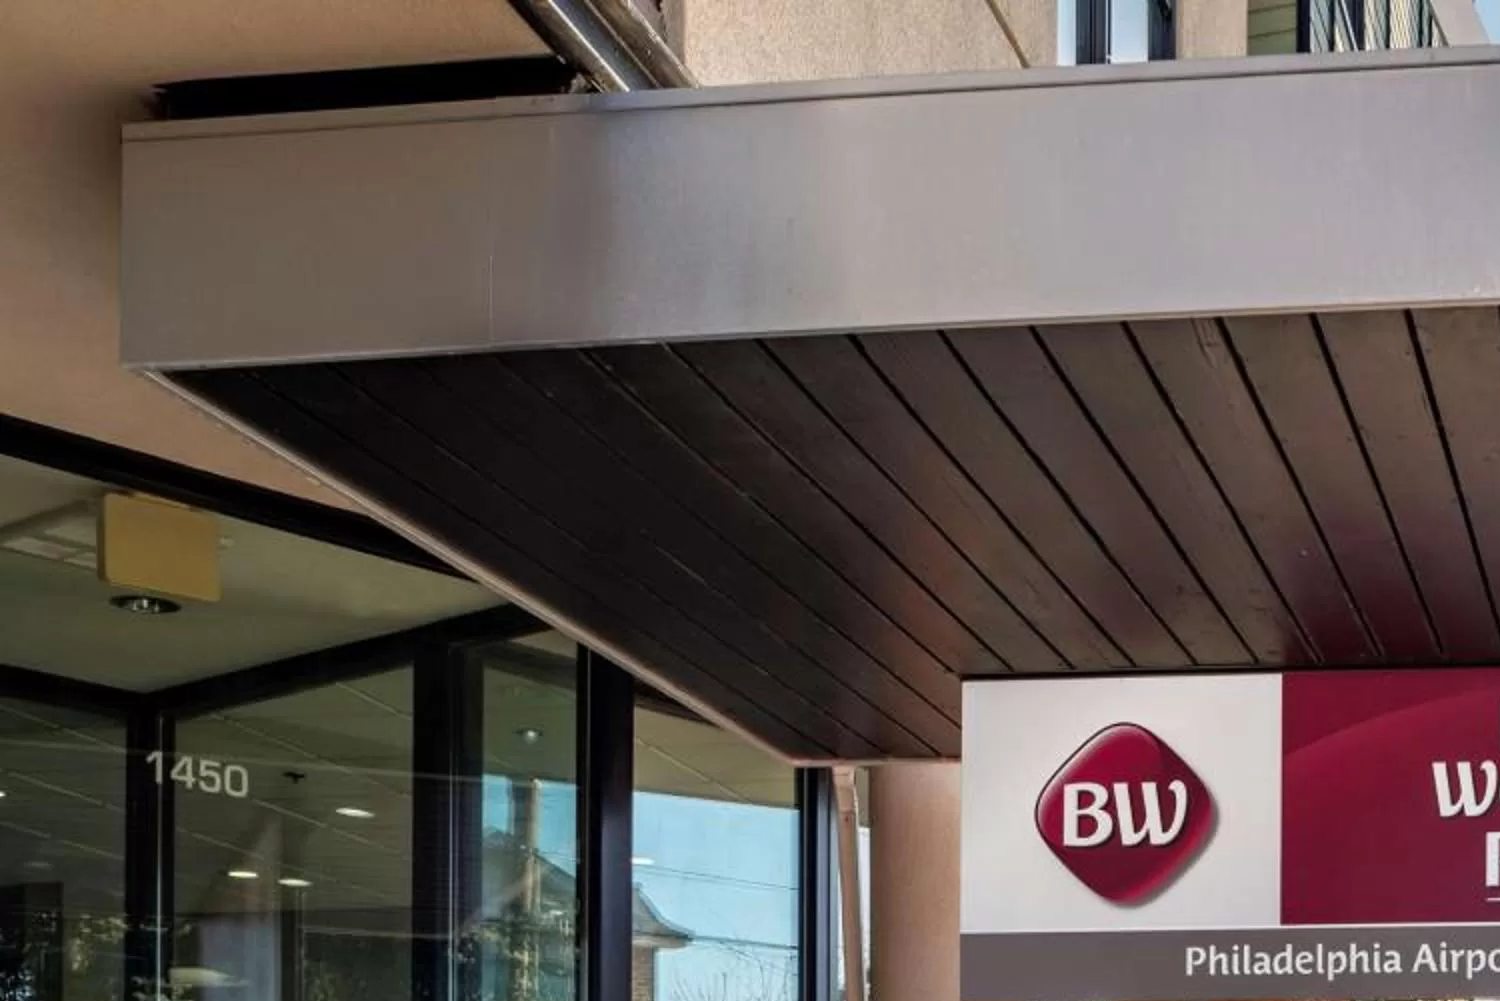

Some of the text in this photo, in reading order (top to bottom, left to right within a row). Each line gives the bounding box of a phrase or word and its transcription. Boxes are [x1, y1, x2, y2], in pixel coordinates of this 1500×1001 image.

[146, 750, 249, 798] 1450
[1062, 779, 1189, 848] BW
[1185, 942, 1402, 981] Philadelphia
